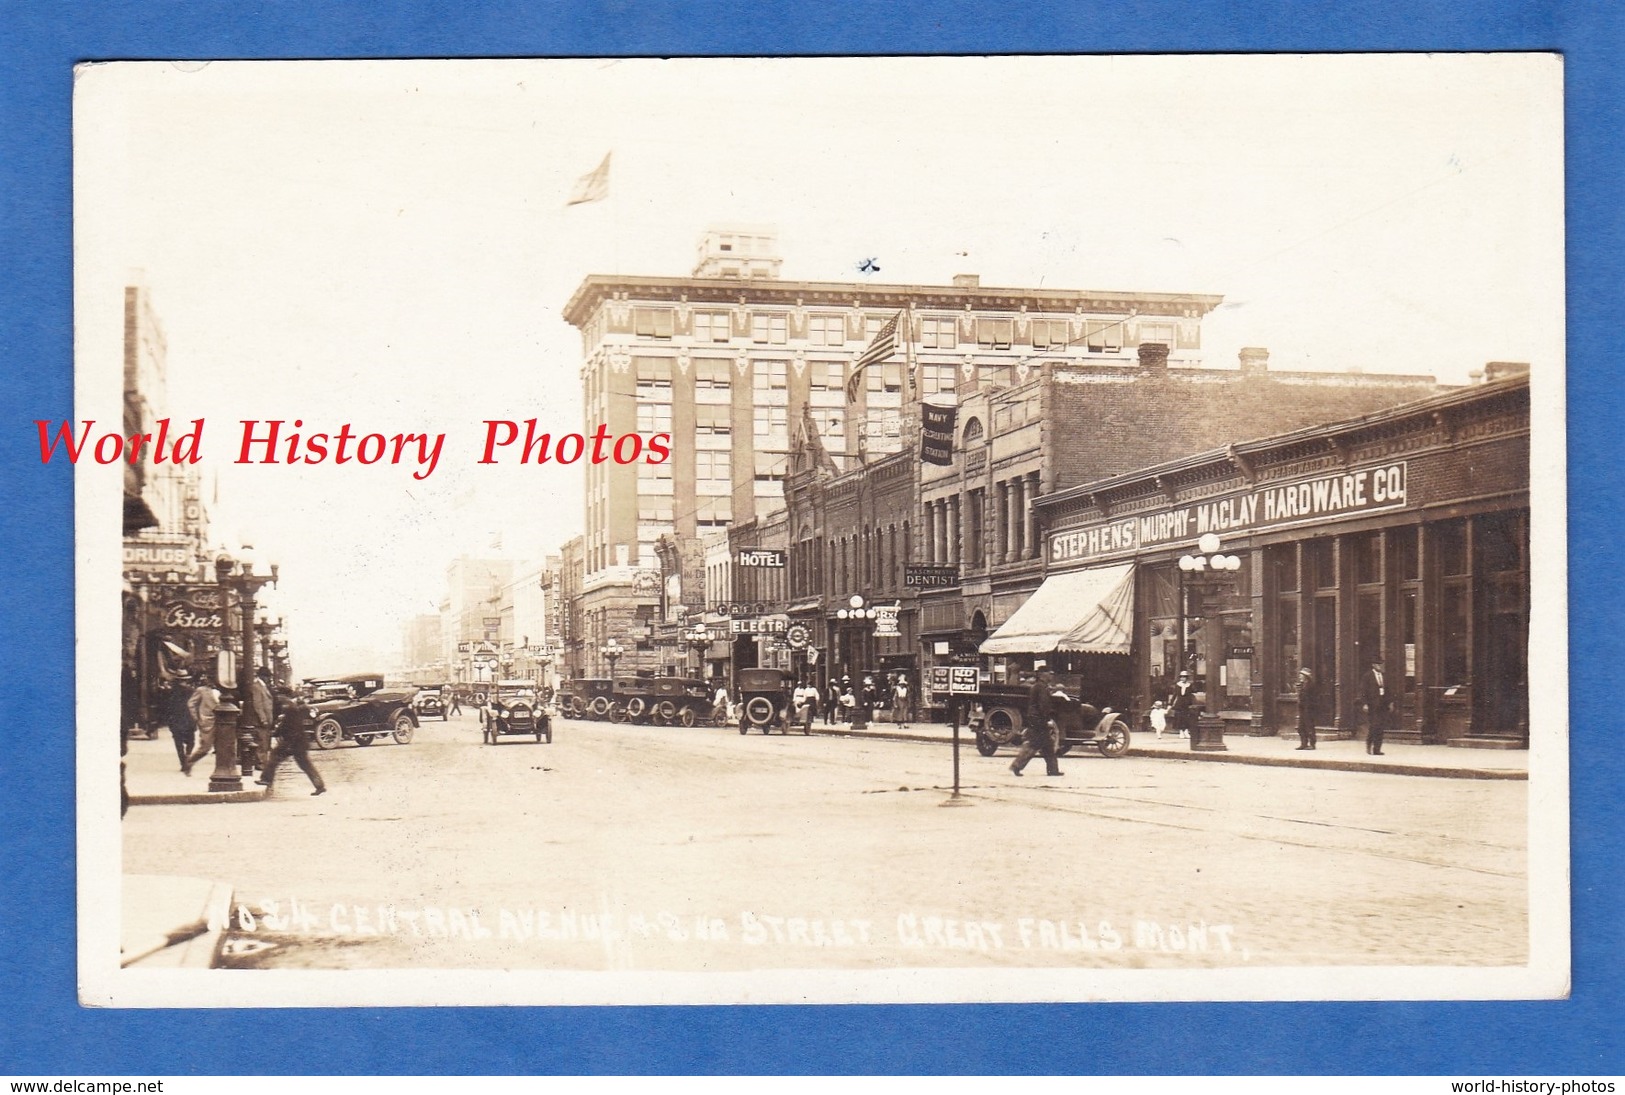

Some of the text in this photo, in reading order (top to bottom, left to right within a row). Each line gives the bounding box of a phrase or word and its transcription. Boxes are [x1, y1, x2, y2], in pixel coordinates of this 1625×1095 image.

[928, 412, 948, 423] NAVY
[1264, 471, 1367, 521] HARDWARE
[122, 548, 187, 564] DRUGS
[739, 552, 784, 567] HOTEL
[952, 682, 976, 691] RIGHT
[329, 902, 493, 942] CENTRAL
[740, 910, 872, 946] STREET
[1018, 917, 1123, 952] FALLS
